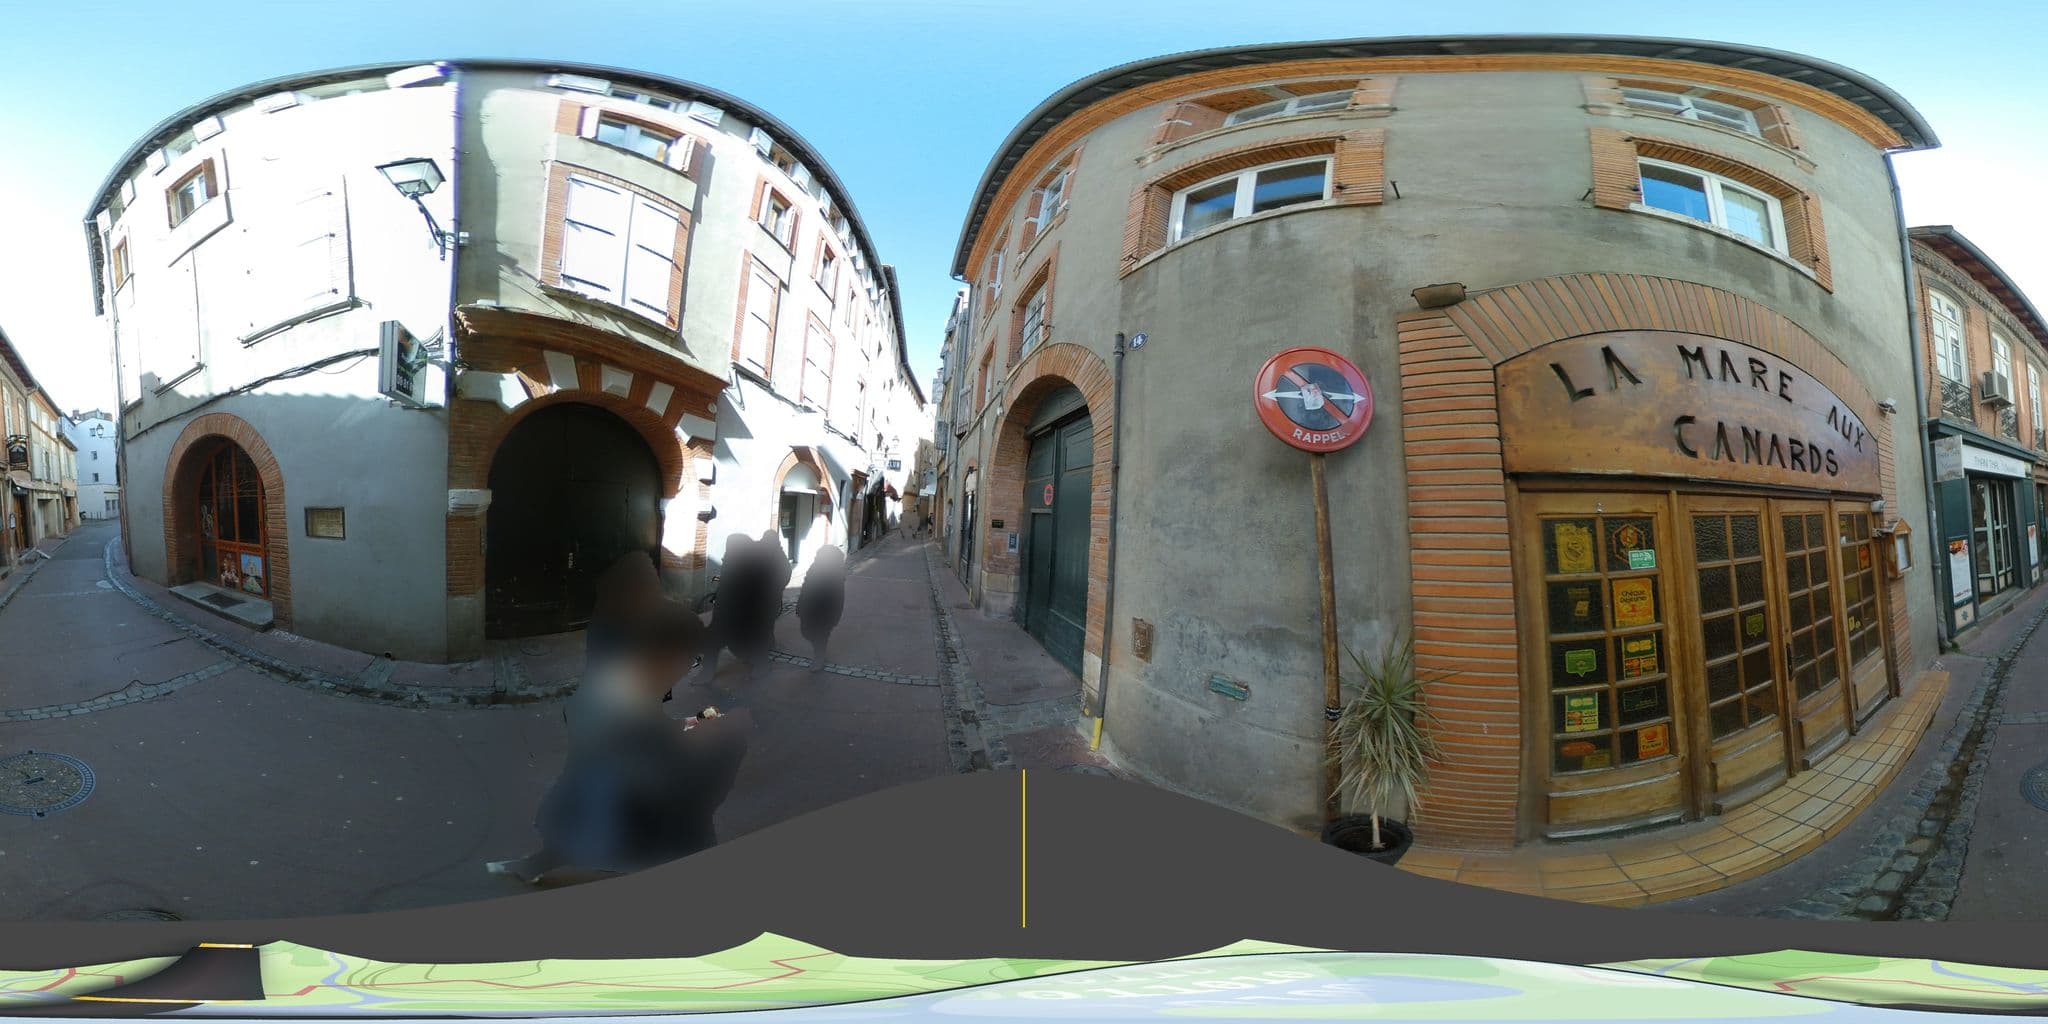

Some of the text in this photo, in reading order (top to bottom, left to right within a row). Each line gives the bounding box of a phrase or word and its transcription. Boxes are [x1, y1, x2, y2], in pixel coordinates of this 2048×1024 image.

[1549, 344, 1865, 453] LA MARE AUX
[1292, 427, 1346, 444] RAPPEL
[1673, 415, 1839, 477] CANARDS
